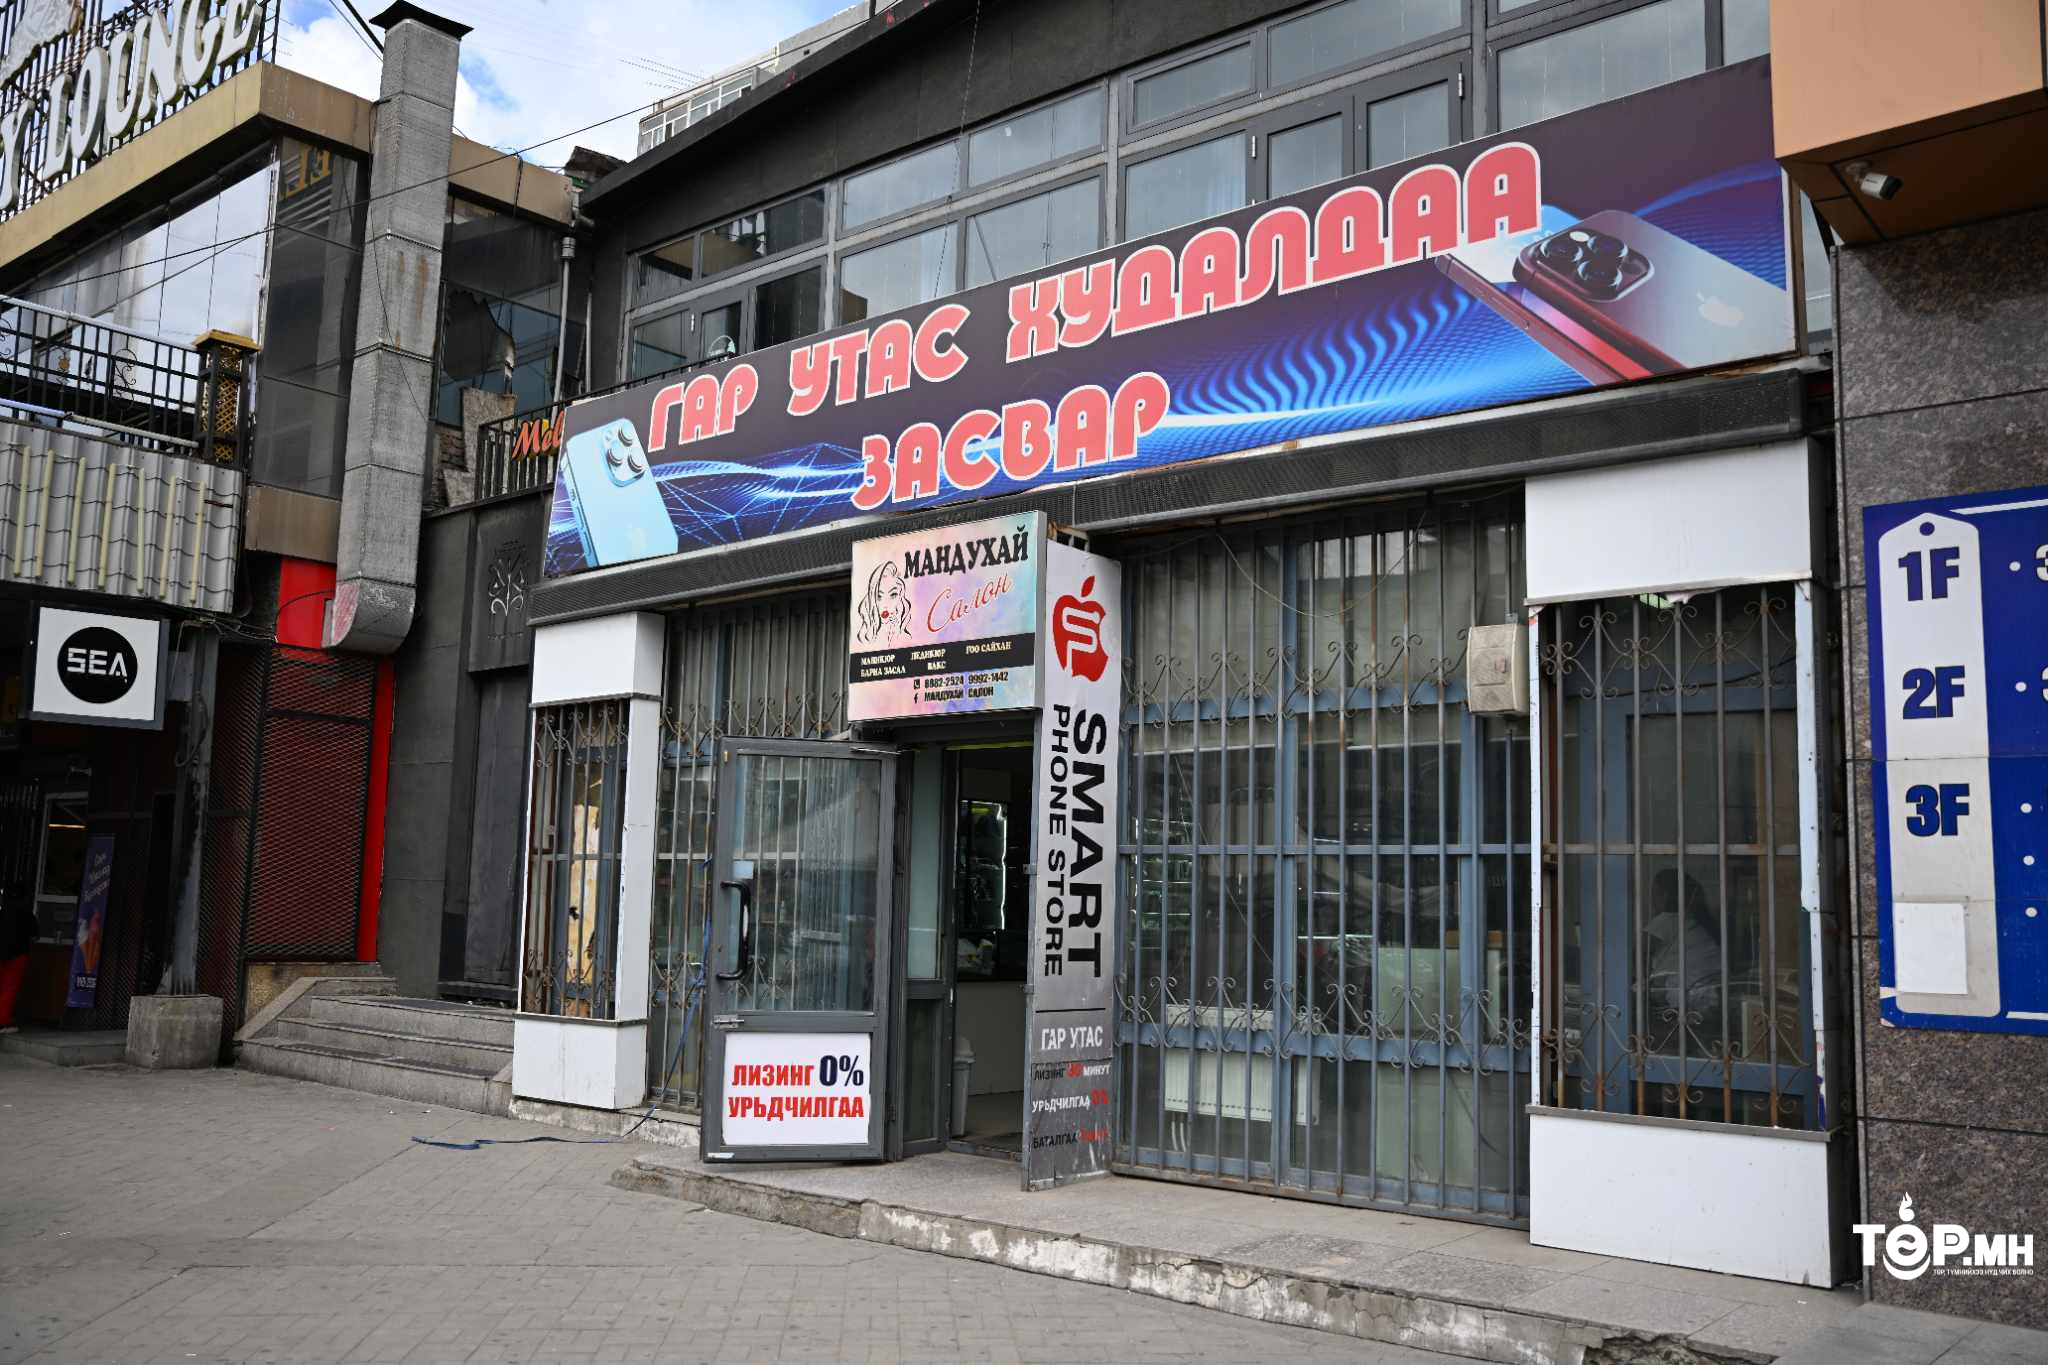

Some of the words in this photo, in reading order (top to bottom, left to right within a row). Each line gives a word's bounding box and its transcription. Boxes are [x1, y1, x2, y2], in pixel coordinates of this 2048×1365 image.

[42, 0, 263, 182] LOUNGE
[648, 363, 759, 453] ГАР
[786, 303, 971, 417] УТАС
[1005, 141, 1542, 363] ХУДАЛДАА
[851, 371, 1171, 510] ЗАСВАР
[903, 523, 1029, 579] МАНДУХАЙ
[1897, 546, 1961, 602] 1F
[67, 647, 127, 677] SEA
[1902, 665, 1965, 720] 2F
[1049, 704, 1071, 836] PHONE
[1905, 783, 1969, 837] 3F
[1067, 708, 1107, 978] SMART
[1044, 848, 1067, 977] STORE
[1041, 1027, 1066, 1050] ГАР
[1069, 1025, 1104, 1049] УТАС
[731, 1064, 815, 1087] ЛИЗИНГ
[819, 1054, 864, 1088] 0%
[728, 1096, 865, 1122] УРЬДЧИЛГАА
